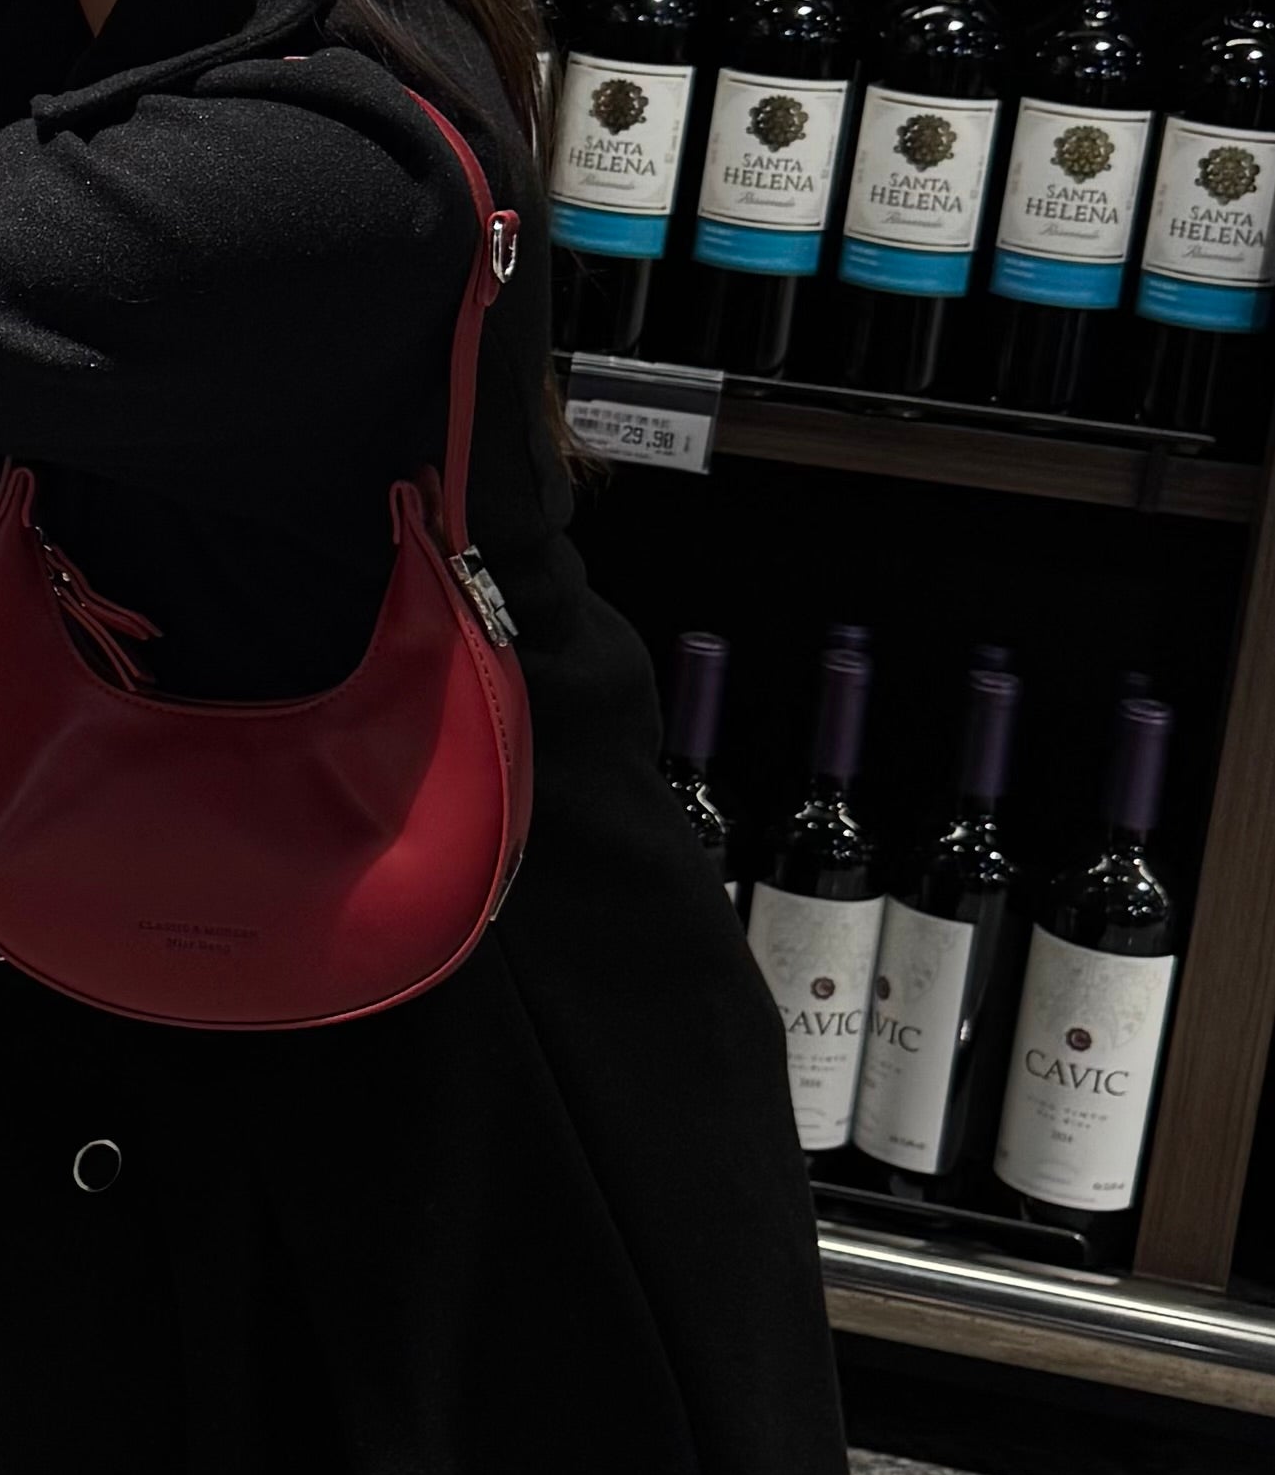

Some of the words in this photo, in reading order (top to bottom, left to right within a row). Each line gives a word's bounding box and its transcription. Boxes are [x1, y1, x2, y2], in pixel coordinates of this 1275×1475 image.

[584, 134, 644, 157] SANTA
[569, 147, 657, 177] HELENA
[743, 152, 803, 174] SANTA
[723, 166, 815, 193] HELENA
[888, 172, 951, 193] SANTA
[870, 185, 963, 213] HELENA
[1046, 184, 1108, 206] SANTA
[1025, 197, 1119, 225] HELENA
[1190, 205, 1253, 226] SANTA
[1170, 218, 1266, 248] HELENA
[1025, 1049, 1129, 1098] CAVIC
